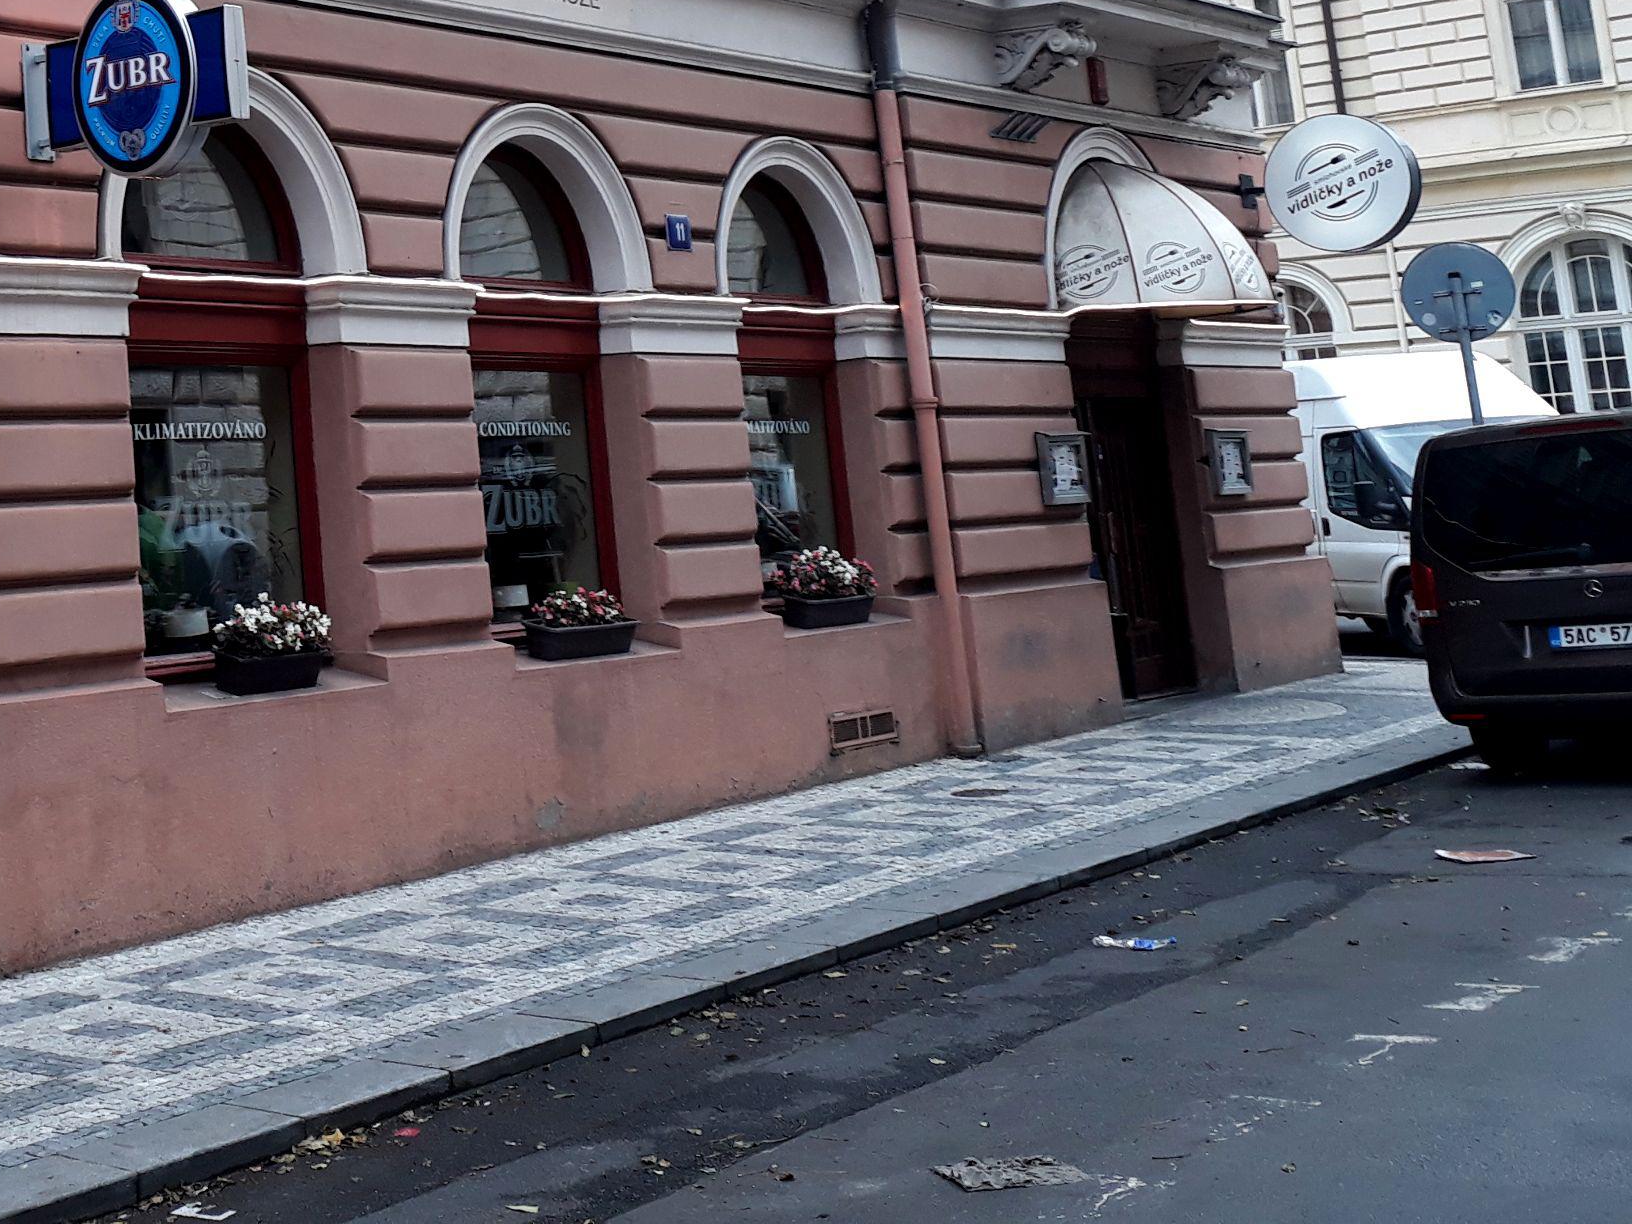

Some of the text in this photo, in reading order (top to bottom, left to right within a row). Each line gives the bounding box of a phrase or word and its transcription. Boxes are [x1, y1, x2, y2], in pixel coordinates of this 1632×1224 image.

[86, 52, 176, 108] ZUBR
[1287, 157, 1394, 215] vidličky a nože
[1143, 265, 1181, 288] vidličky
[133, 419, 267, 441] KLIMATIZOVÁNO
[479, 421, 572, 437] CONDITIONING
[746, 418, 810, 434] MATIZOVÁNO
[1563, 625, 1632, 645] 5AC 57
